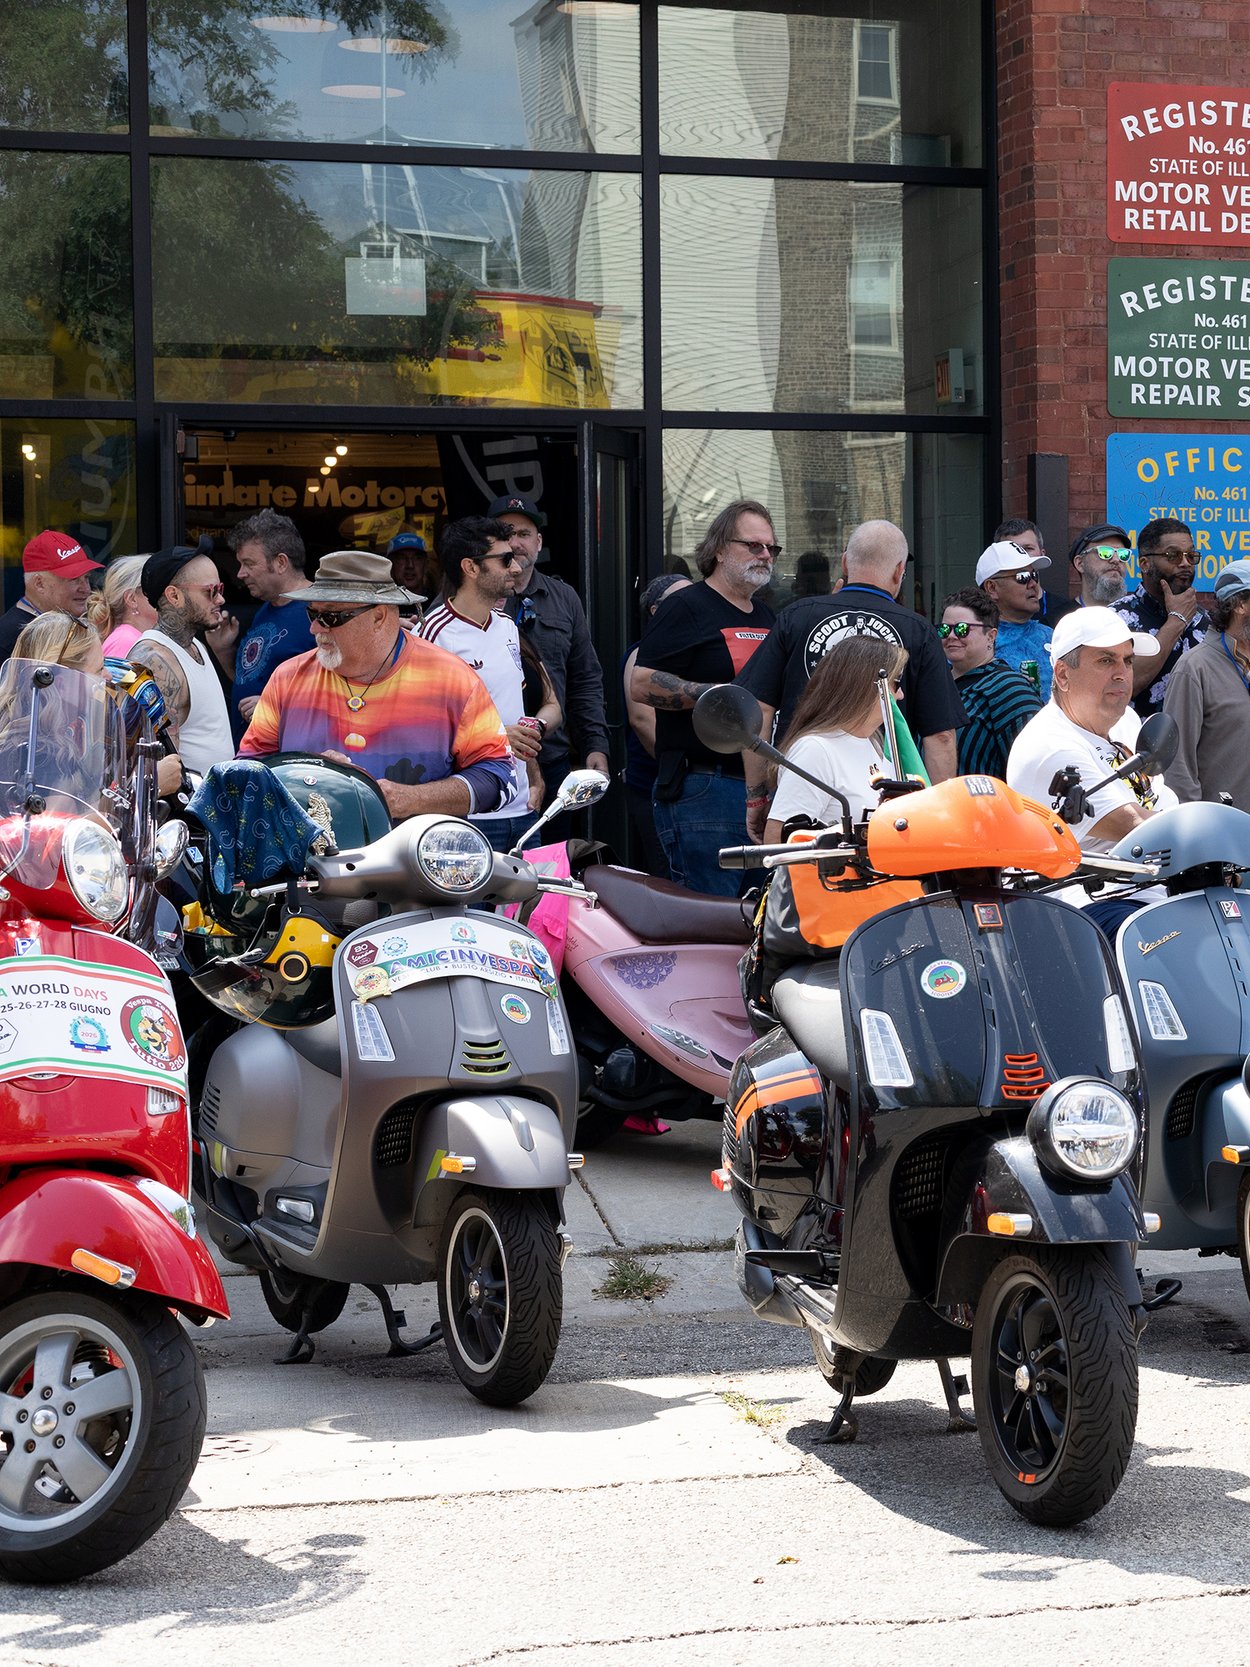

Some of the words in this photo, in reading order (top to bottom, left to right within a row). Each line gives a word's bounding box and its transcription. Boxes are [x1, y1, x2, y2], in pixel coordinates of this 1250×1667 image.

[1188, 136, 1220, 155] No.
[1149, 158, 1198, 174] STATE
[1202, 160, 1224, 176] OF
[1115, 180, 1210, 205] MOTOR
[1124, 208, 1212, 232] RETAIL
[1194, 313, 1219, 328] No.
[1222, 314, 1247, 328] 461
[1149, 333, 1197, 349] STATE
[1201, 335, 1222, 350] OF
[1114, 355, 1211, 380] MOTOR
[1131, 383, 1222, 407] REPAIR
[1194, 486, 1219, 501] No.
[1222, 487, 1248, 501] 461
[1149, 507, 1197, 523] STATE
[1201, 508, 1222, 523] OF
[57, 543, 82, 562] Vespa
[809, 615, 848, 654] SCOOT
[867, 618, 898, 646] JOCK
[970, 783, 994, 795] RIDE
[102, 788, 131, 810] GTS
[354, 943, 370, 953] 80
[1138, 930, 1182, 956] Vespa
[389, 949, 534, 977] AMICINVESPA
[451, 964, 478, 973] BUSTO
[479, 966, 507, 979] ARSIZIO
[11, 983, 70, 995] WORLD
[73, 986, 109, 1001] DAYS
[69, 1003, 111, 1016] GIUGNO
[126, 998, 152, 1010] Vespa
[154, 1001, 177, 1025] Team
[129, 1038, 166, 1070] Tutto
[169, 1055, 184, 1071] 220
